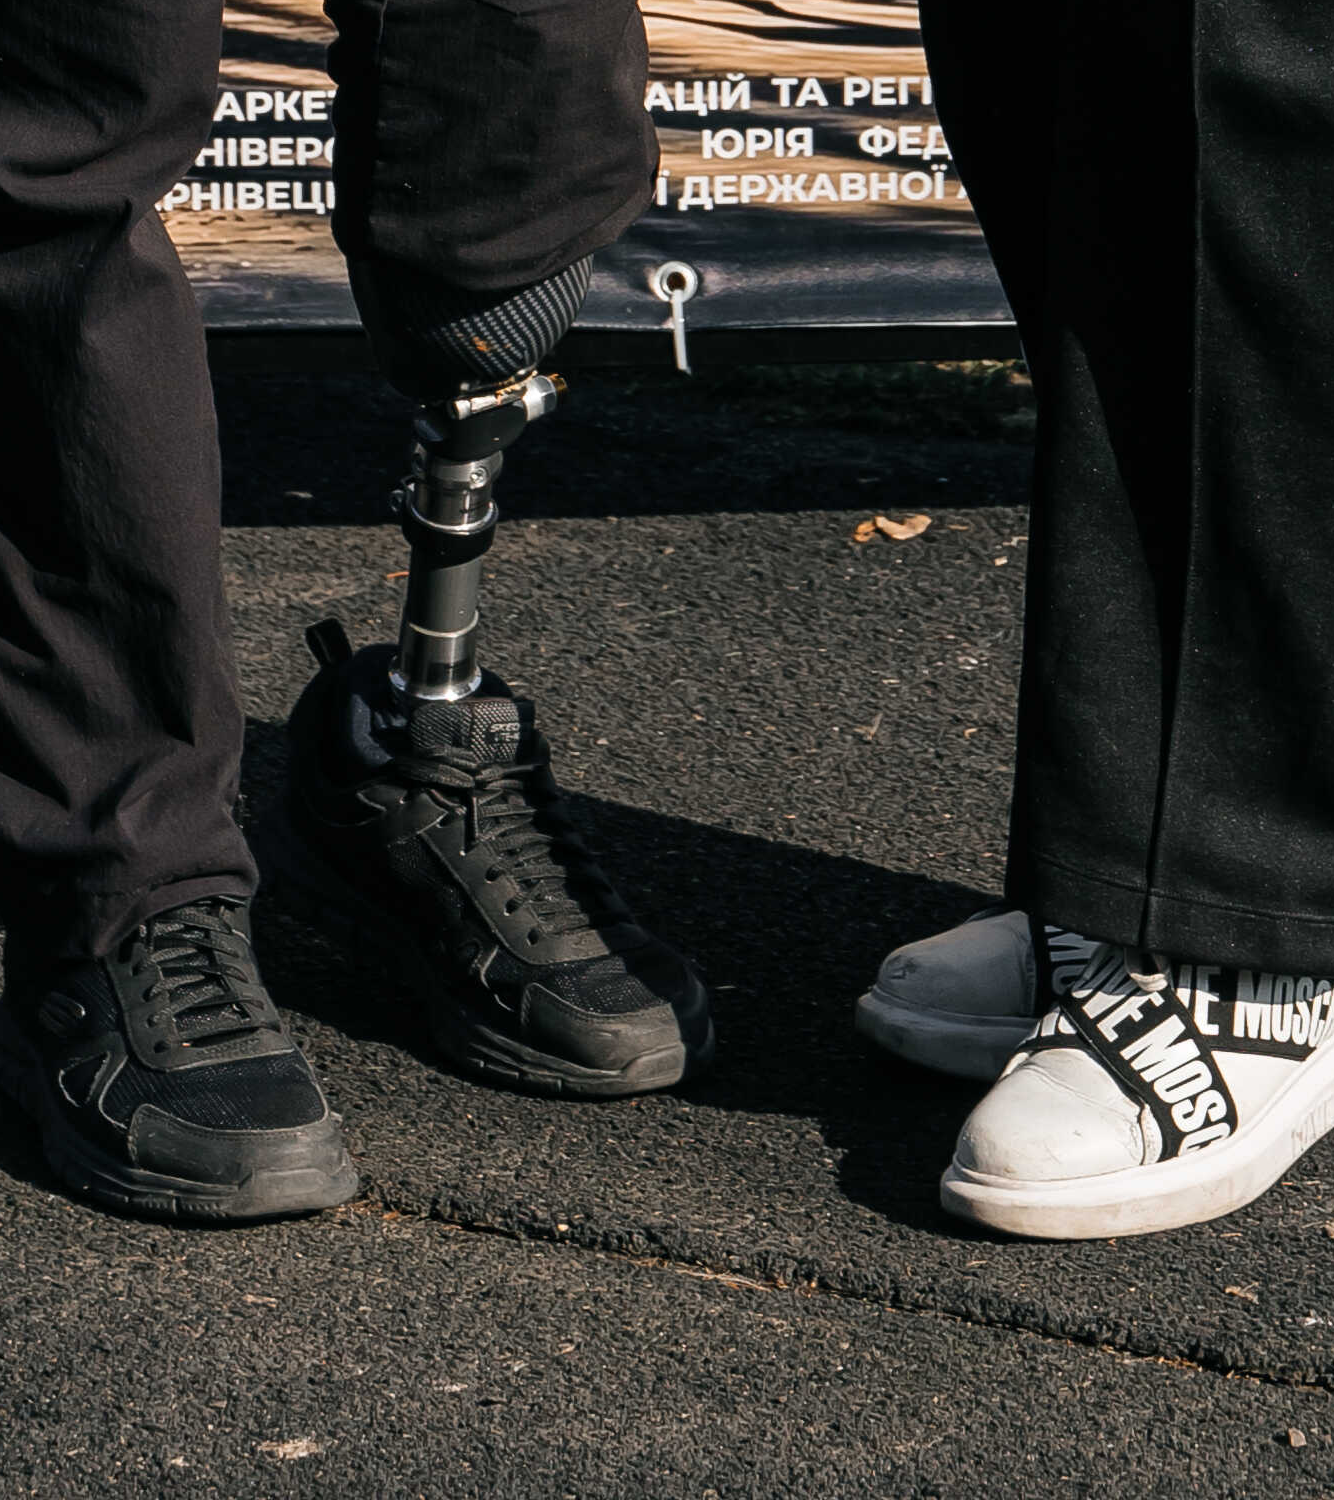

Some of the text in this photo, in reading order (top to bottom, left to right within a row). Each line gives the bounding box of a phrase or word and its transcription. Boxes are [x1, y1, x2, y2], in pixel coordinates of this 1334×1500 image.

[213, 90, 336, 122] АРКЕ
[771, 77, 829, 108] ТА
[702, 126, 815, 160] ЮРІЯ
[677, 163, 948, 212] ДЕРЖАВНОЇ
